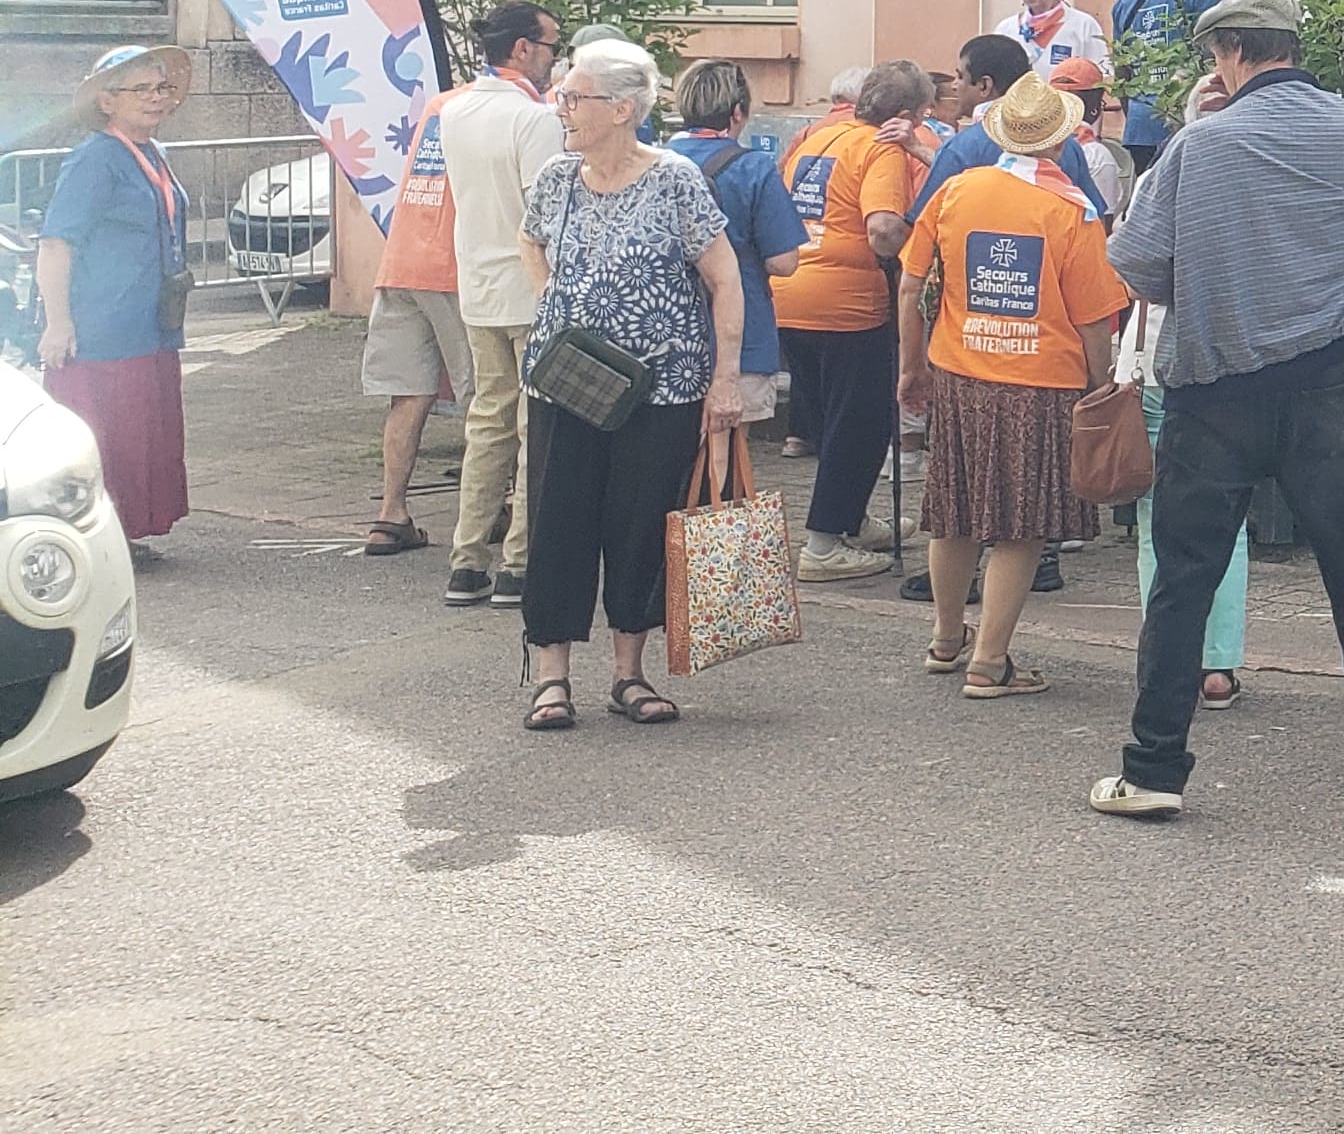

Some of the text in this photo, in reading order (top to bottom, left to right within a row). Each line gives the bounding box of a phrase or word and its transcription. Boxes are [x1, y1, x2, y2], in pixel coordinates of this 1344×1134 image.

[976, 266, 1028, 283] Secours
[970, 278, 1036, 298] Catholique
[971, 294, 1034, 311] Caritas France
[963, 317, 1039, 337] #RÉVOLUTION
[962, 334, 1039, 355] FRATERNELLE
